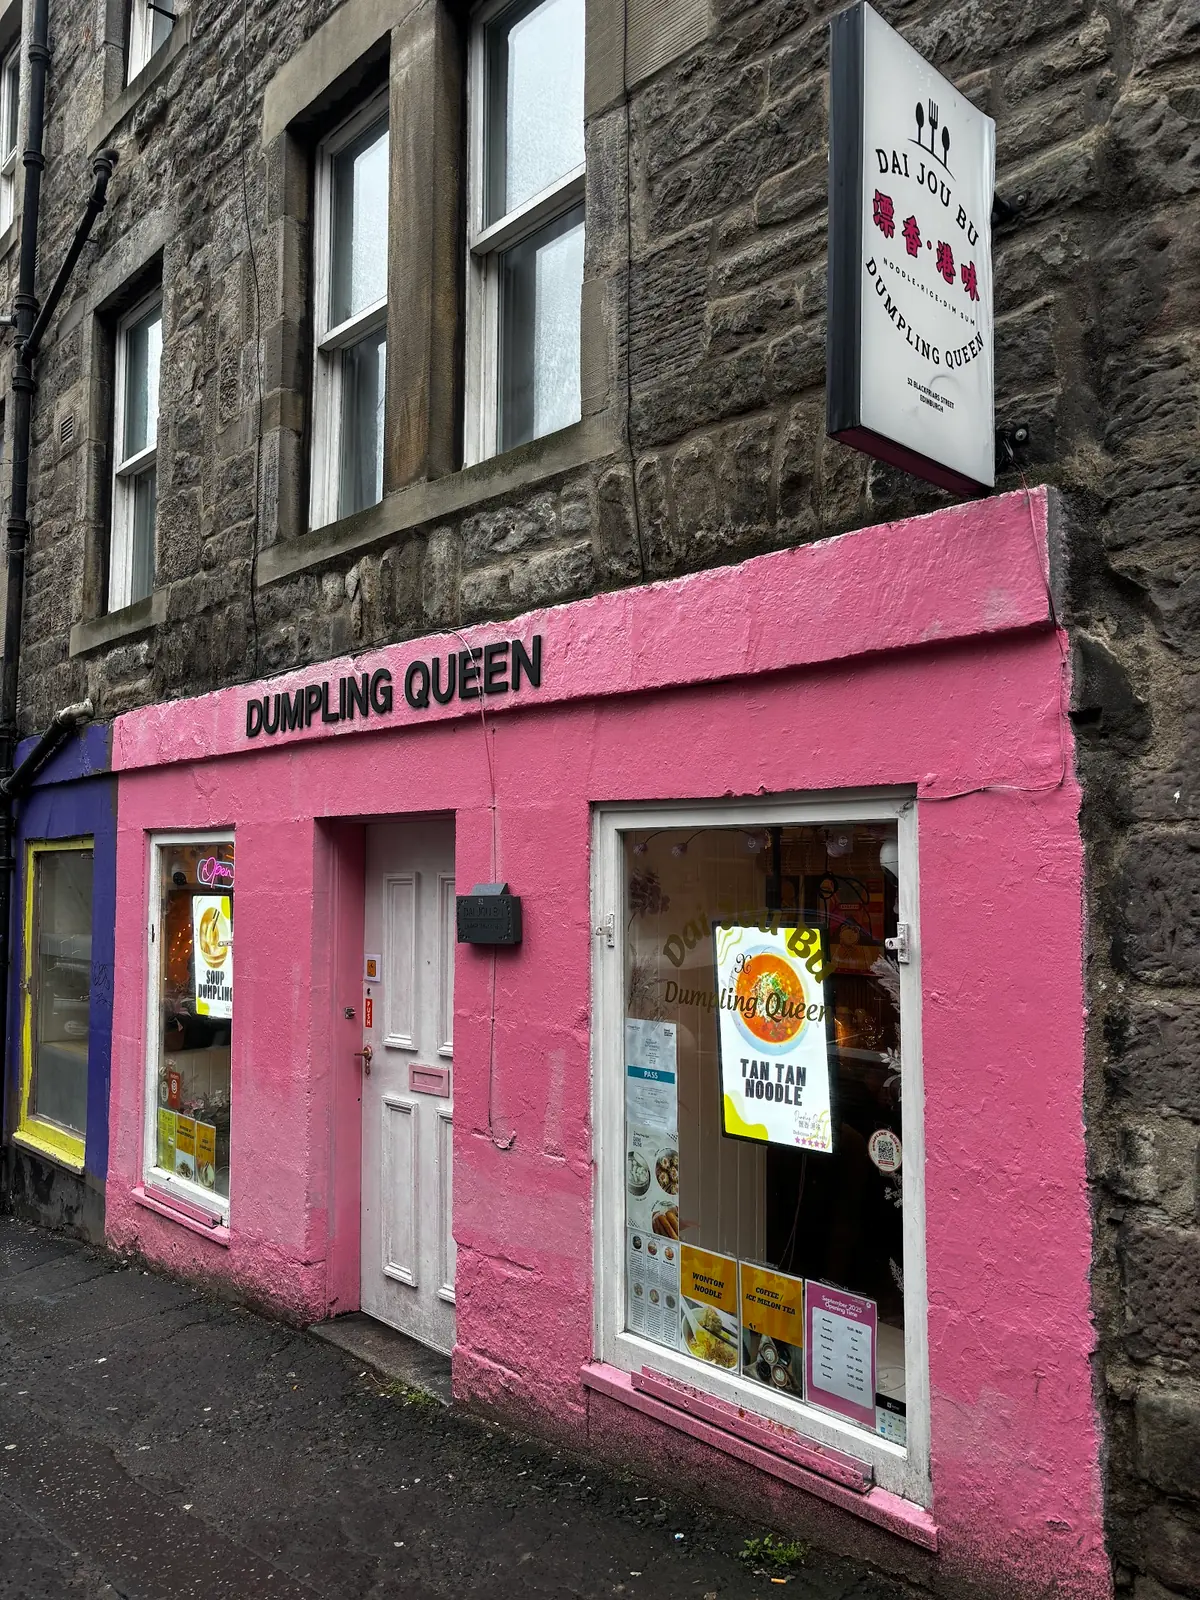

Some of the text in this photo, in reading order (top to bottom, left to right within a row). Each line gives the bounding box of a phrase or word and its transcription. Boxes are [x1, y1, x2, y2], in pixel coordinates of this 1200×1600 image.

[875, 149, 979, 246] DAI JOU BU
[865, 256, 984, 370] DUMPLING QUEEN
[246, 635, 542, 738] DUMPLING QUEEN
[201, 856, 234, 888] Open
[787, 921, 836, 984] Bu
[206, 970, 225, 986] SOUP
[665, 981, 832, 1023] Dumpling Queen
[643, 1070, 659, 1080] PASS
[740, 1058, 807, 1087] TAN TAN
[745, 1079, 803, 1106] NOODLE
[692, 1271, 724, 1289] WONTON
[694, 1284, 722, 1300] NOODLE
[757, 1297, 781, 1311] MELON
[783, 1305, 796, 1316] TEA
[824, 1302, 846, 1315] Opening
